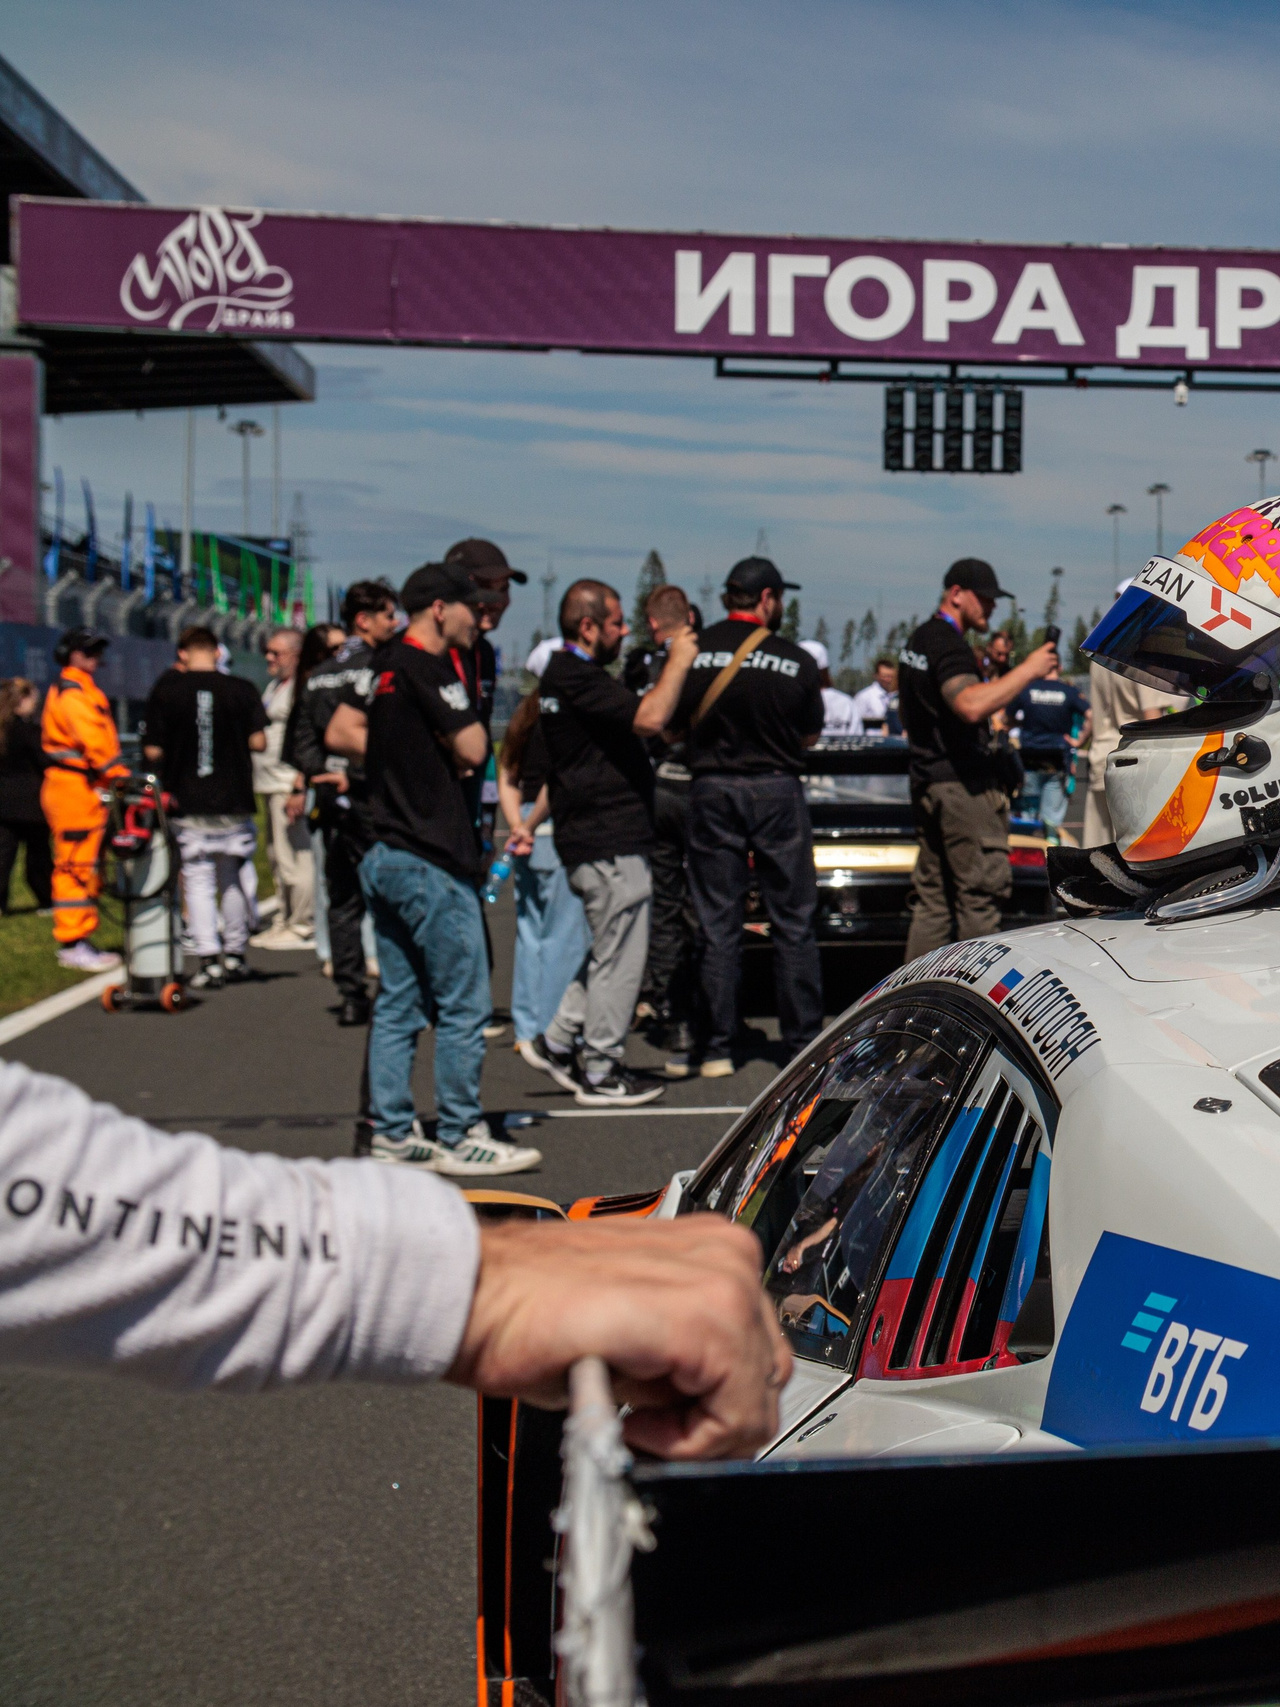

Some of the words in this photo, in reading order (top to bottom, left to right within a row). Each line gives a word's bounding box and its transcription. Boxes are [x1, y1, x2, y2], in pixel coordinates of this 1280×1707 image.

[221, 308, 295, 330] ДРАЙВ
[674, 250, 1086, 346] ИГОРА
[1134, 560, 1195, 602] PLAN
[1140, 1321, 1249, 1431] ВТБ
